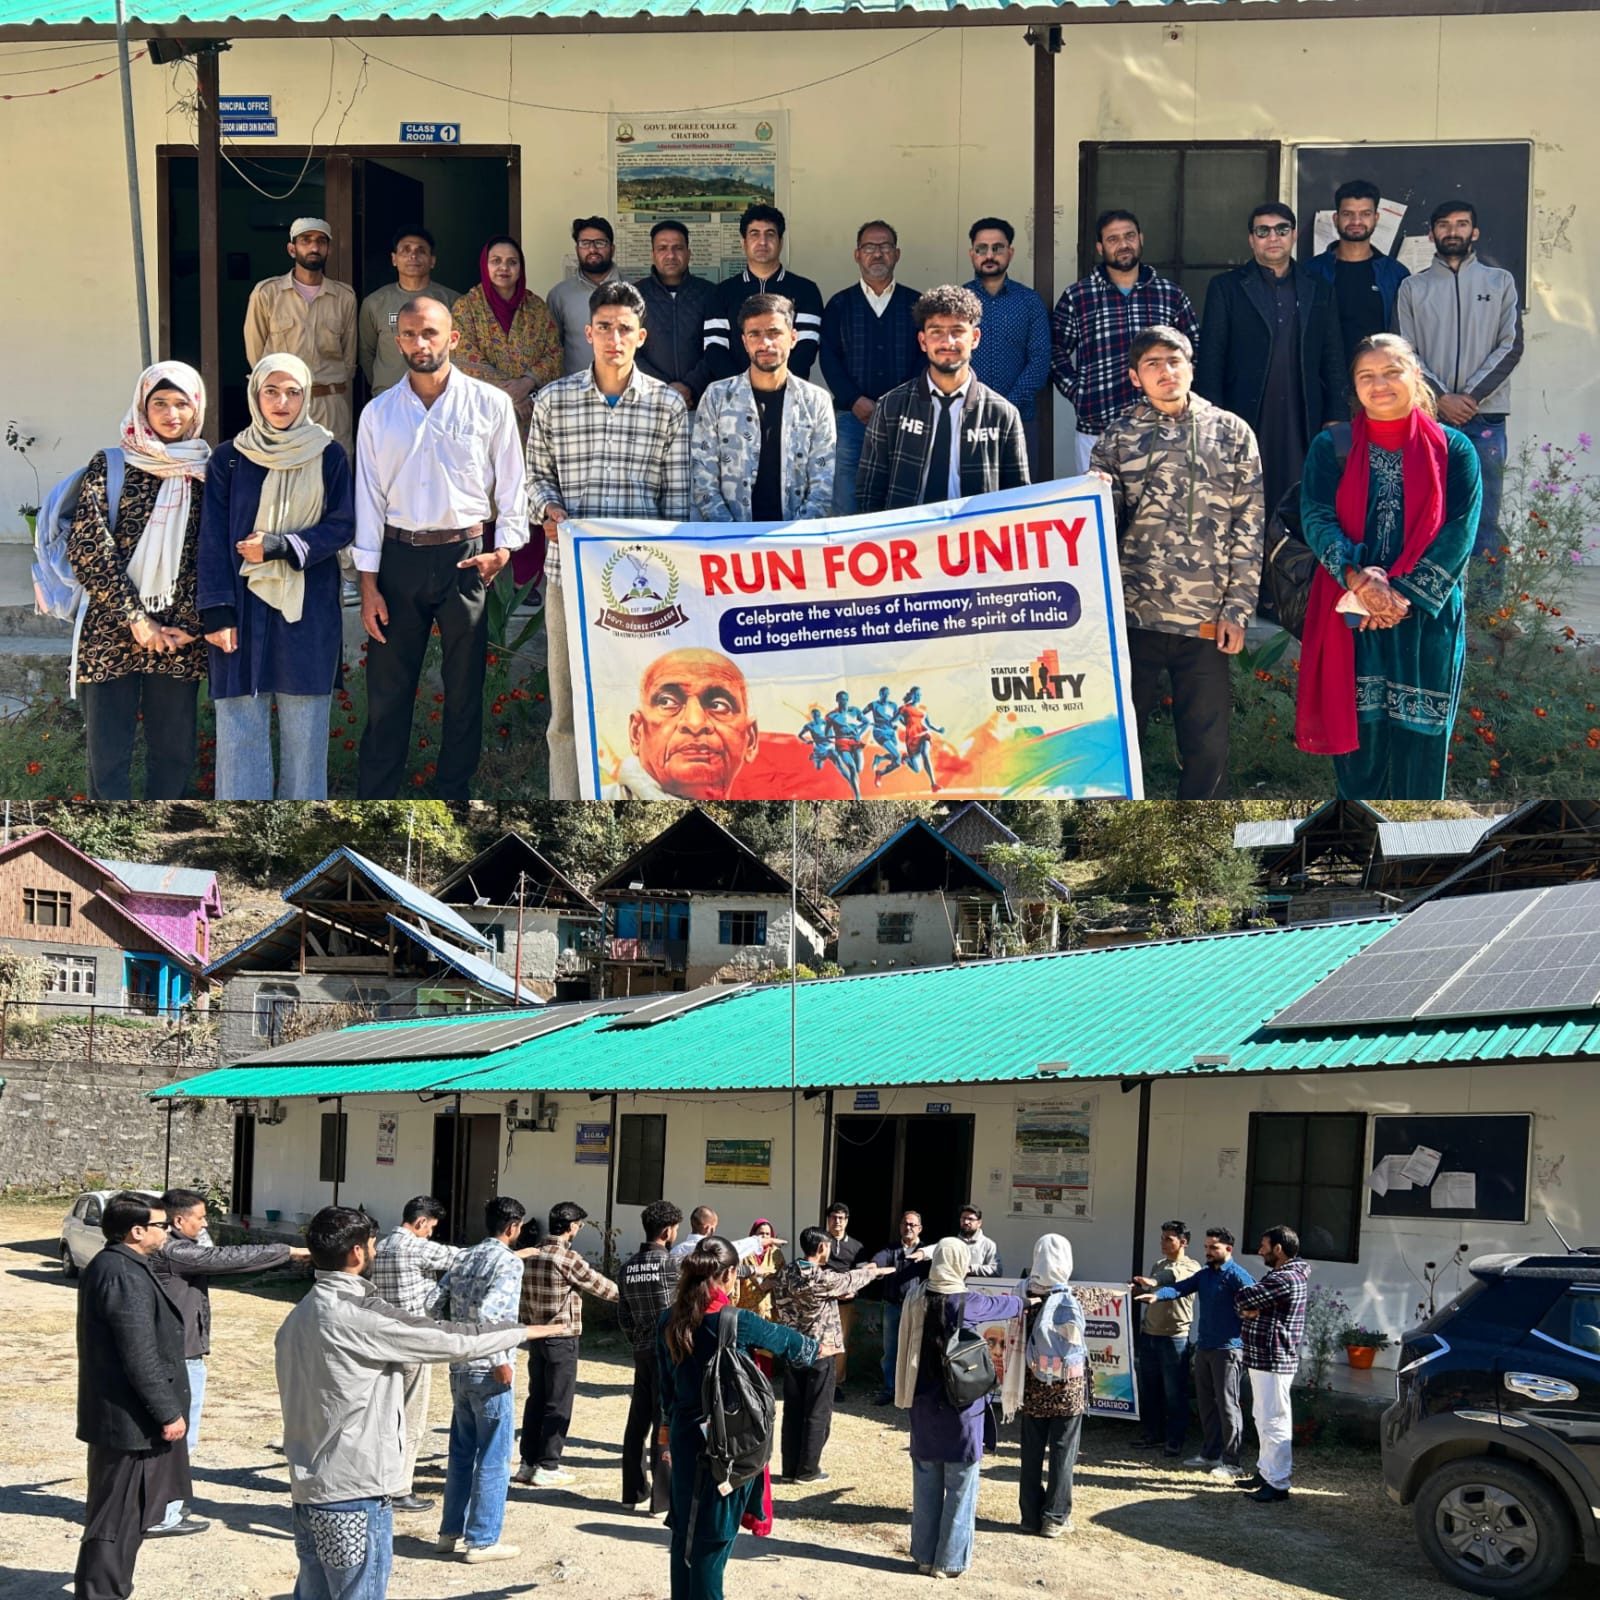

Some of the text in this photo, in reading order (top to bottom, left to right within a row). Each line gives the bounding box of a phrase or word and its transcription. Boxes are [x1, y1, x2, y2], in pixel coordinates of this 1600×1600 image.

[219, 101, 269, 111] RINCIPAL OFFICE
[406, 124, 436, 133] CLASS
[700, 517, 1086, 596] RUN FOR UNITY
[736, 587, 1062, 626] Celebrate the values of harmony, integration,
[625, 621, 649, 630] DEGREE
[650, 610, 675, 629] COLLEGE
[734, 606, 1068, 647] and togetherness that define the spirit of India
[1063, 702, 1084, 712] भारत
[640, 1263, 660, 1271] NEW
[626, 1273, 660, 1284] FASHION
[1097, 1400, 1130, 1410] CHATROO
